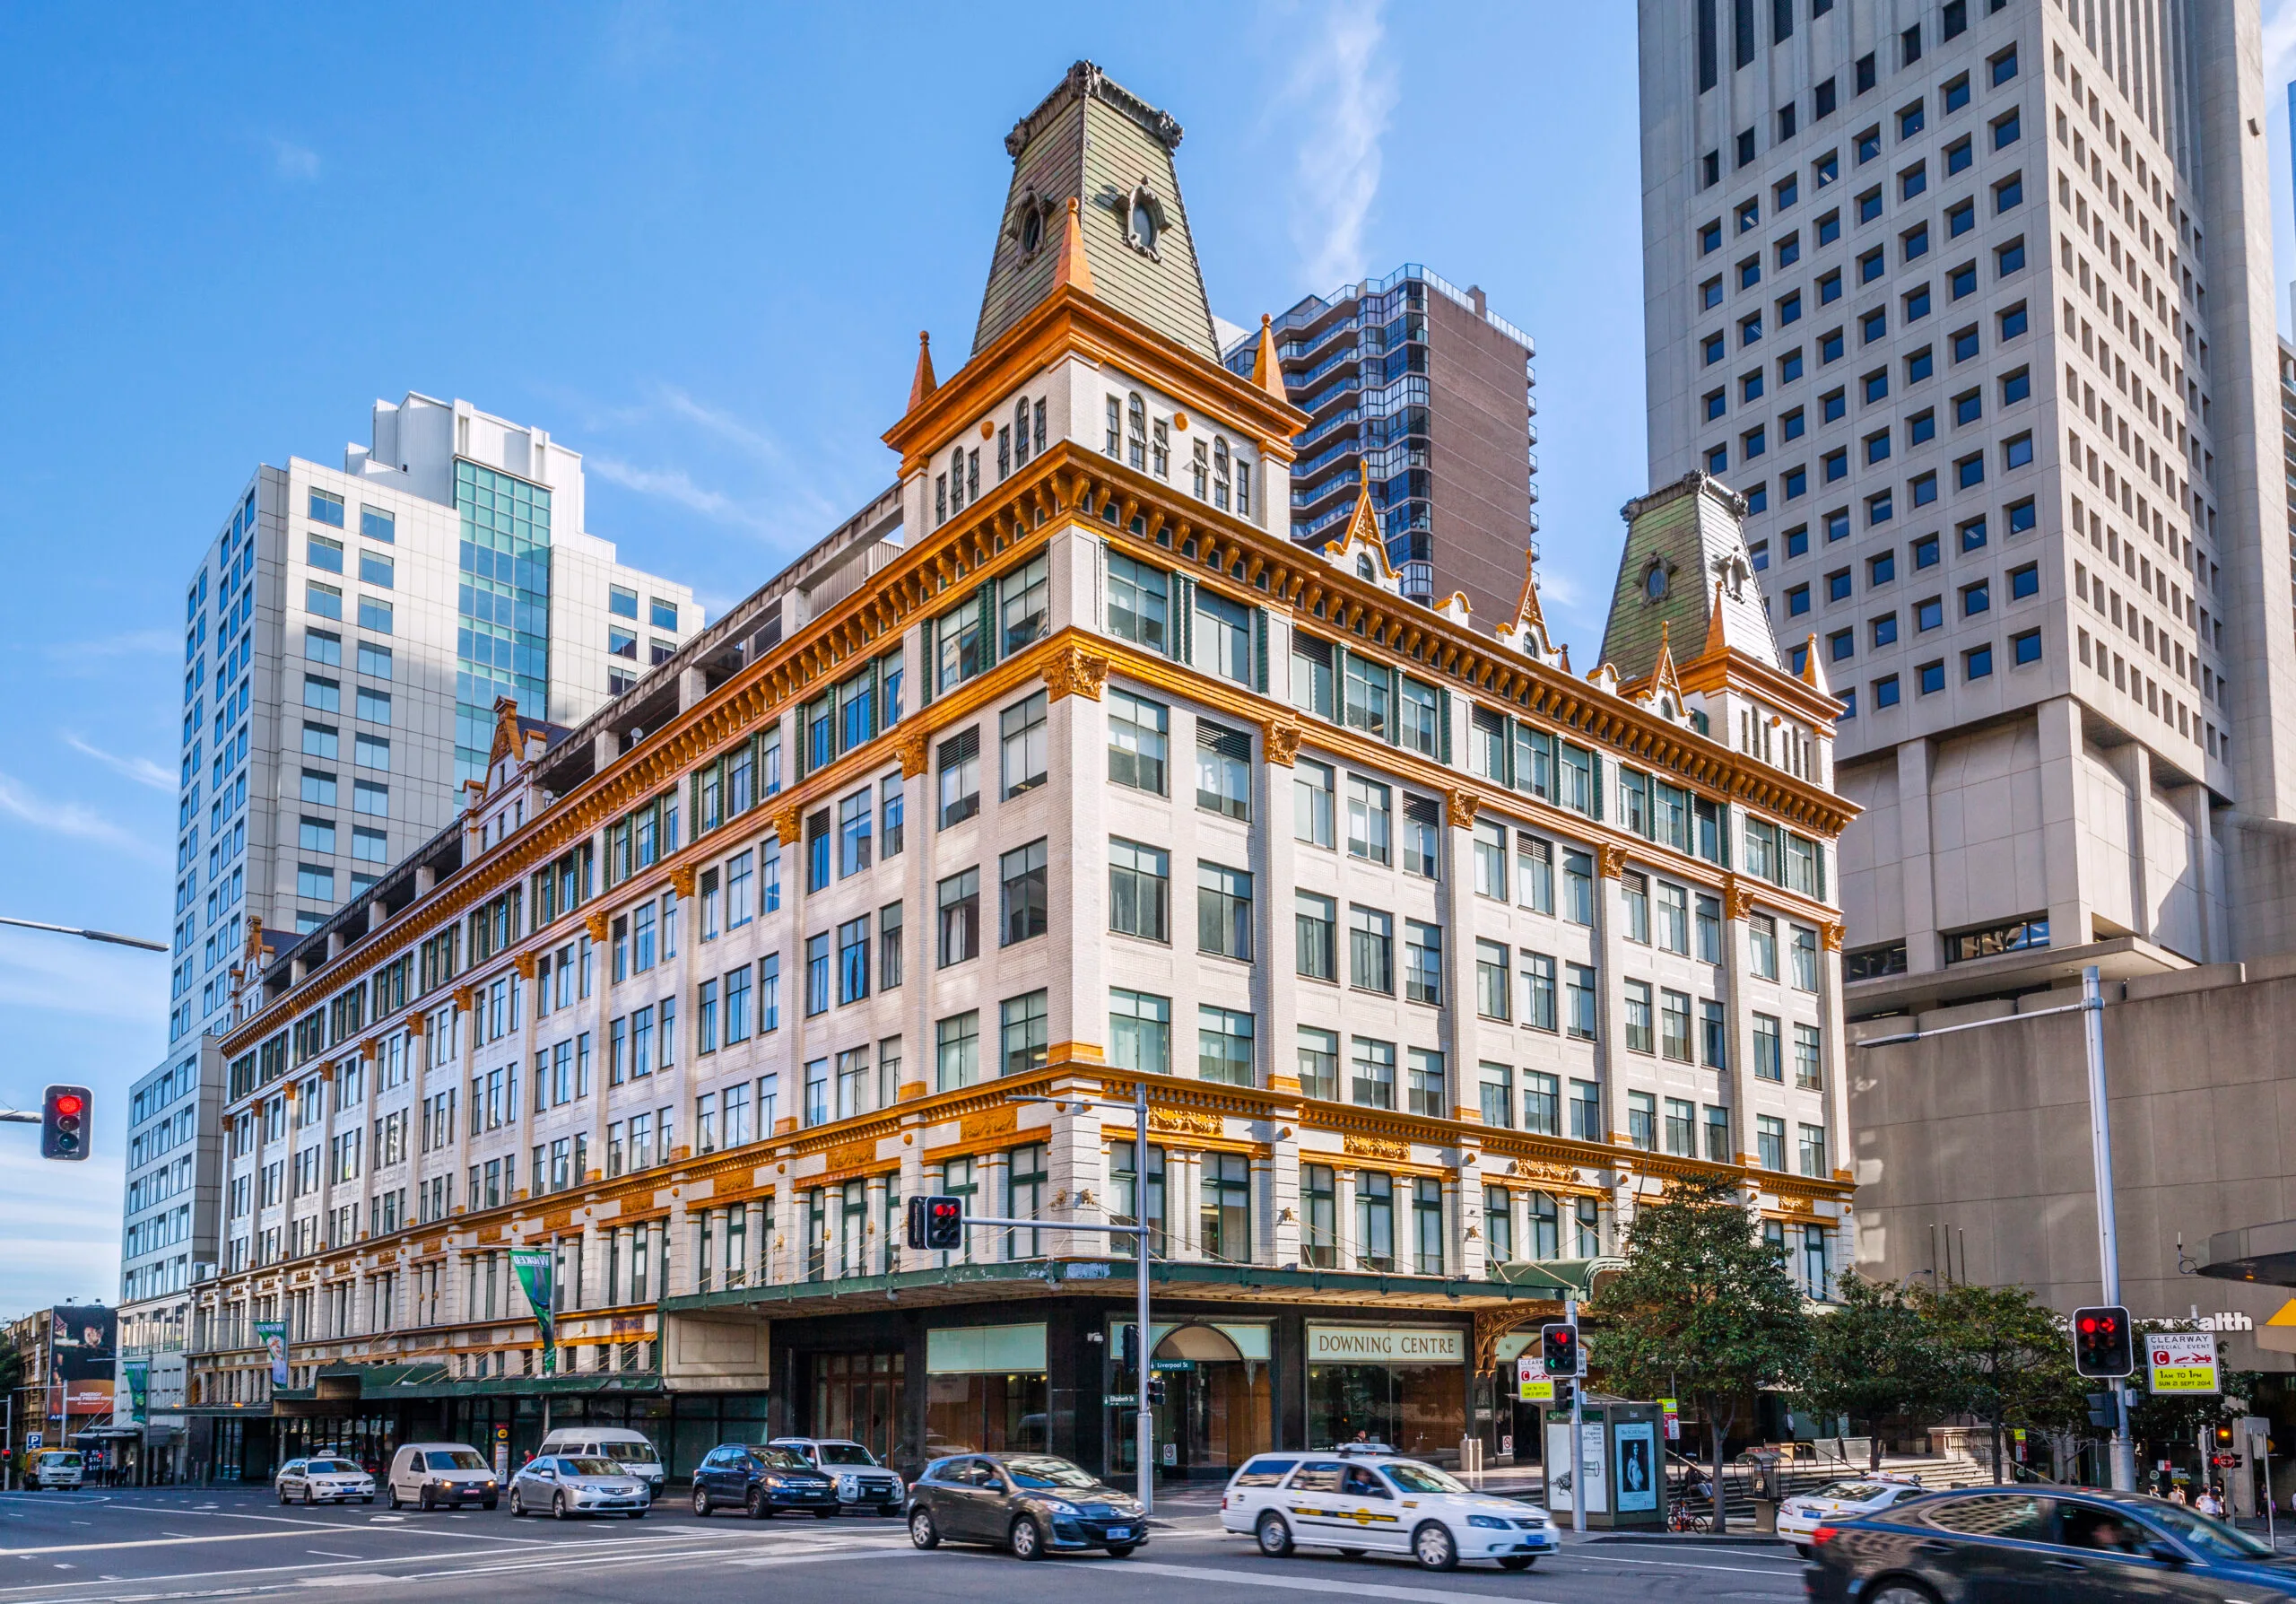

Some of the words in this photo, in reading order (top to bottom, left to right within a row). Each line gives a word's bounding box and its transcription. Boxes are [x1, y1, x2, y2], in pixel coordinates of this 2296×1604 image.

[1319, 1335, 1392, 1353] DOWNING
[1401, 1337, 1454, 1354] CENTRE
[2156, 1352, 2166, 1364] C
[1157, 1361, 1182, 1370] Liverpool
[2160, 1371, 2173, 1379] 1AM
[2188, 1370, 2202, 1378] 1PM
[30, 1436, 39, 1444] P
